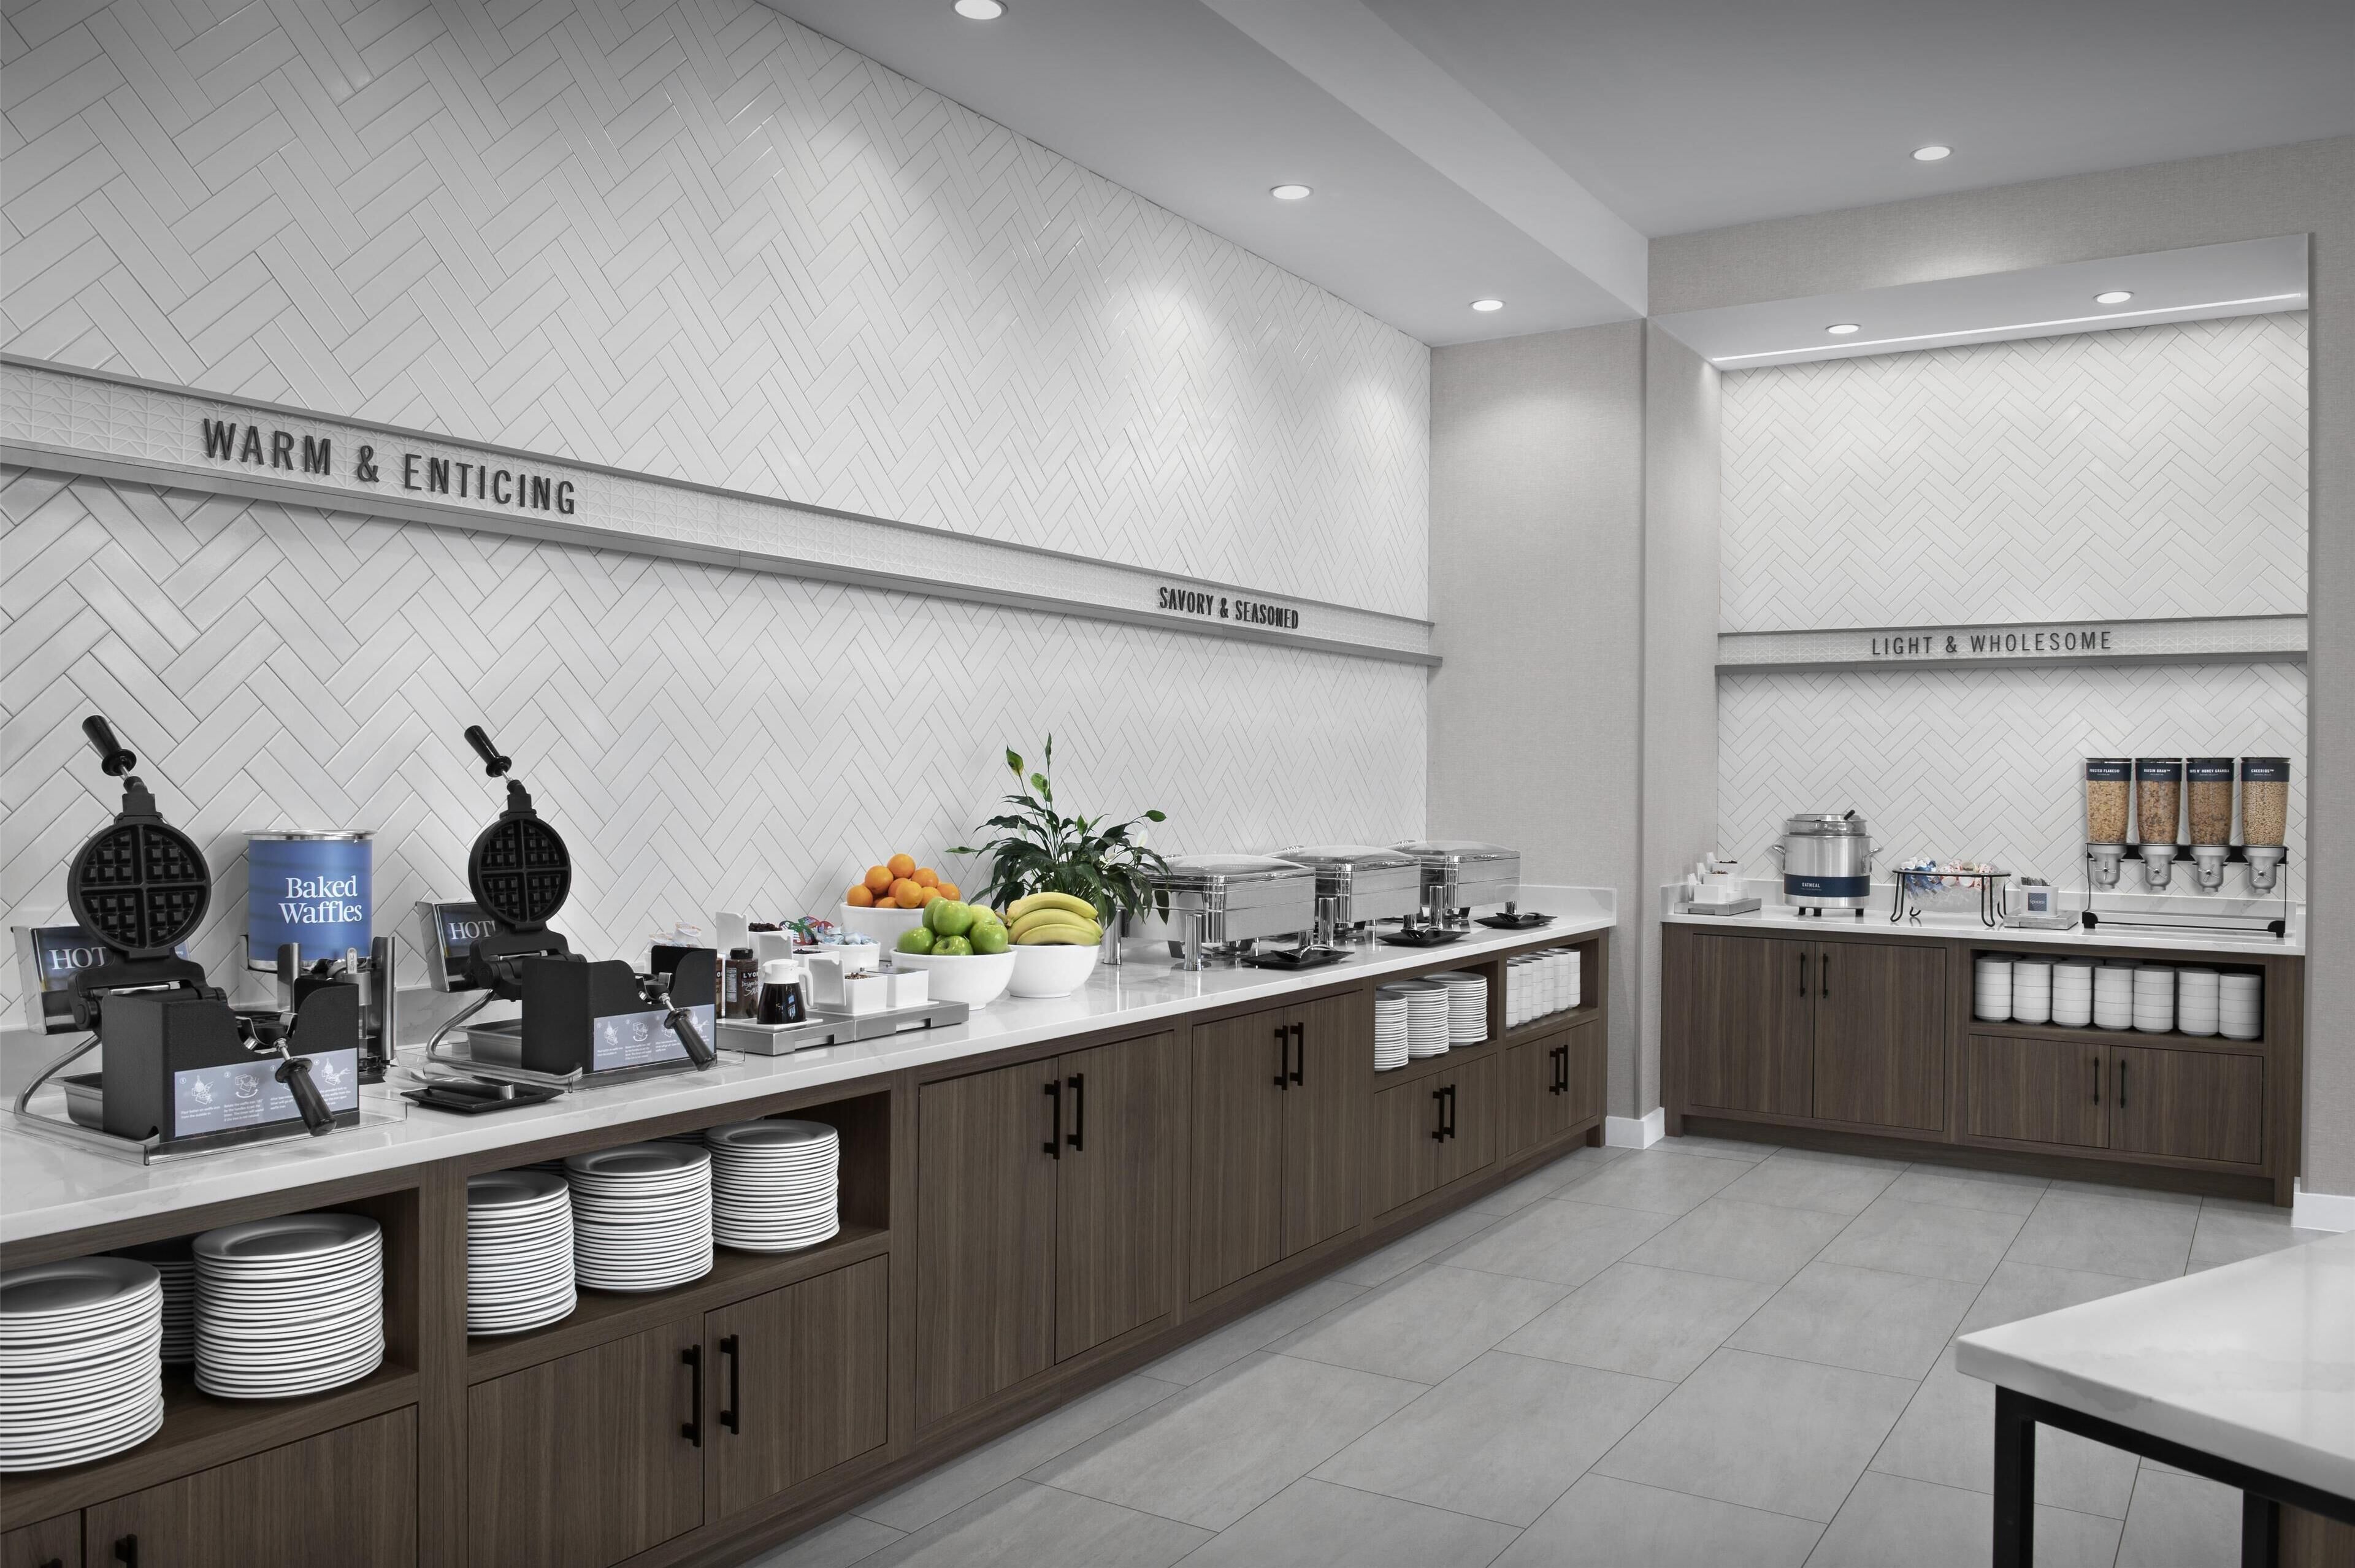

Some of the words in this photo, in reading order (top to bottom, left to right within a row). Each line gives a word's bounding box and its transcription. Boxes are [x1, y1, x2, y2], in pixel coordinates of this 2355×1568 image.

[204, 418, 332, 476] WARM
[357, 445, 380, 483] &
[404, 453, 575, 515] ENTICING
[1159, 586, 1214, 616] SAVORY
[1220, 597, 1228, 619] &
[1235, 600, 1299, 629] SEASONED
[1872, 637, 1932, 656] LIGHT
[1945, 635, 1957, 654] &
[1970, 631, 2111, 652] WHOLESOME
[285, 875, 358, 898] Baked
[278, 900, 362, 924] Waffles
